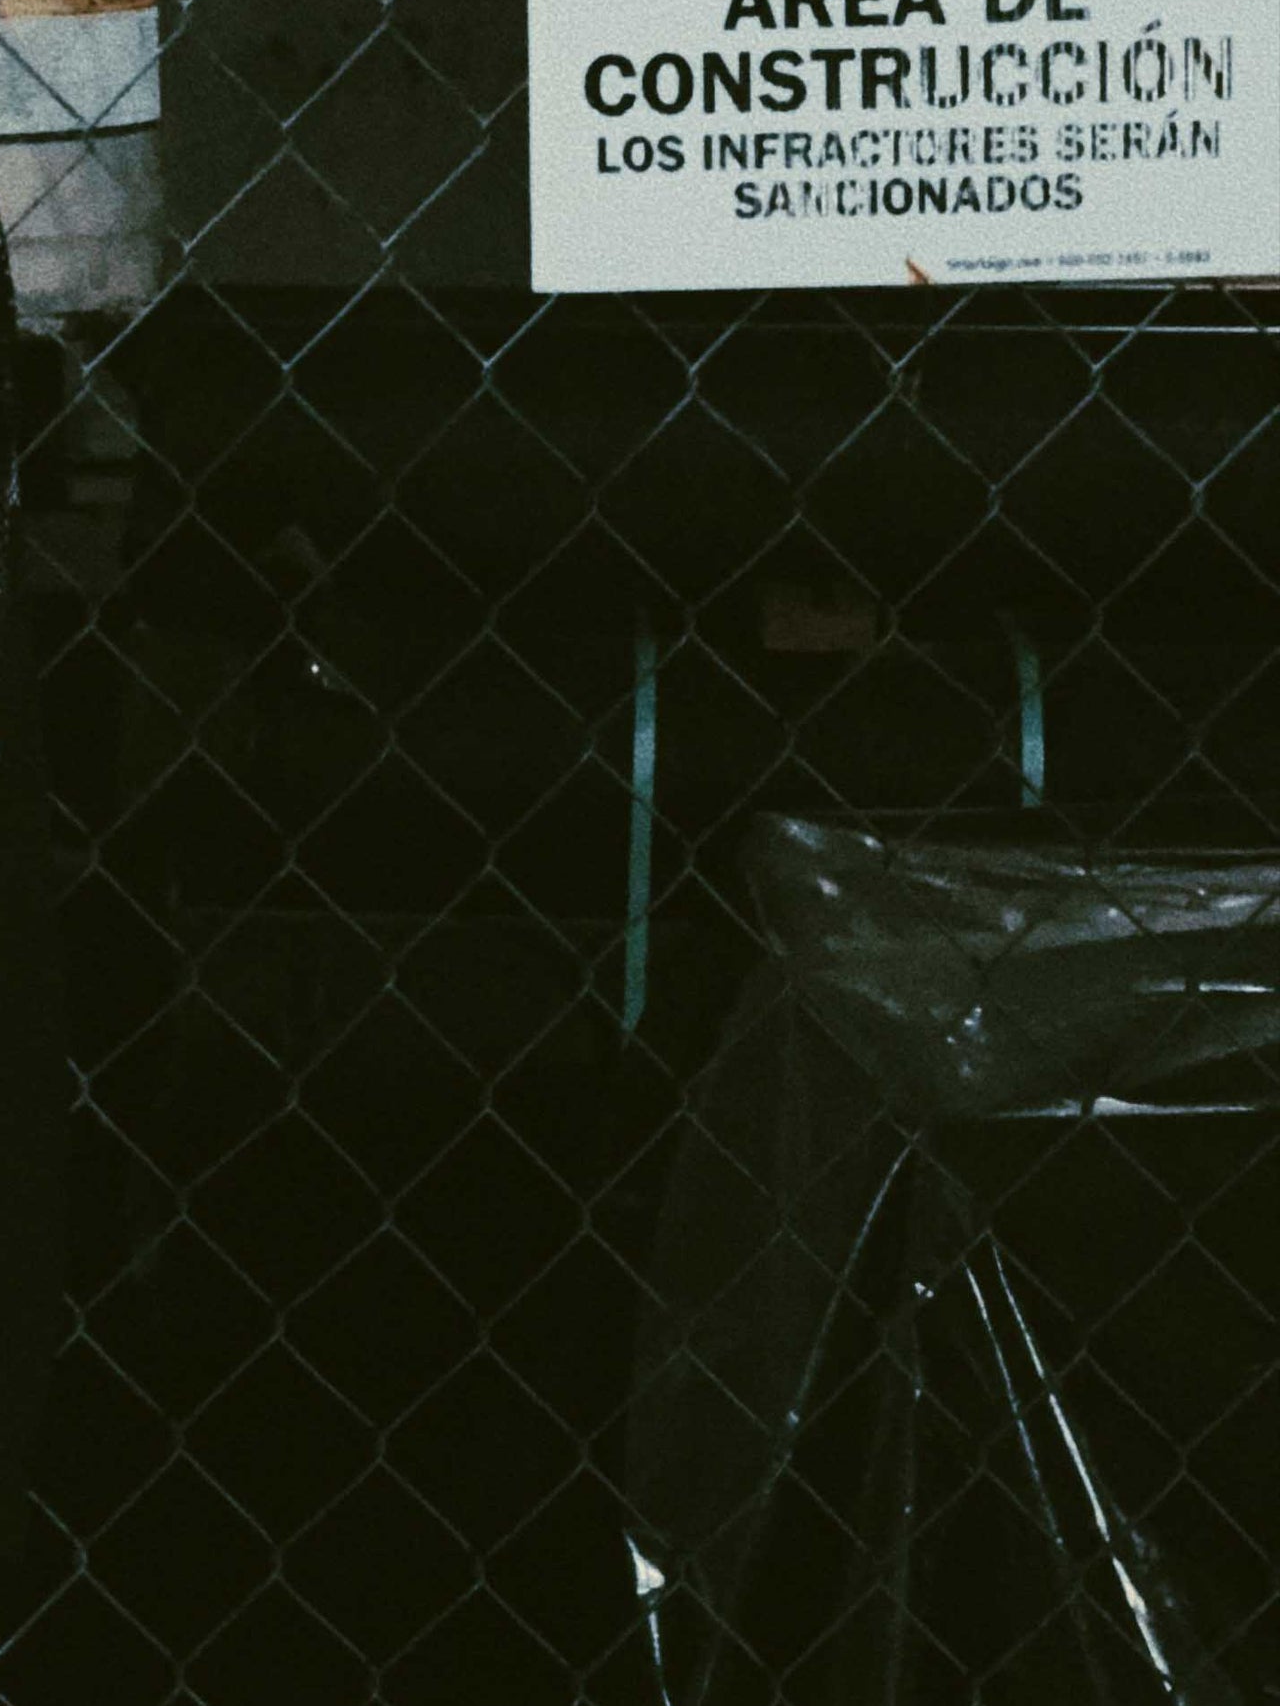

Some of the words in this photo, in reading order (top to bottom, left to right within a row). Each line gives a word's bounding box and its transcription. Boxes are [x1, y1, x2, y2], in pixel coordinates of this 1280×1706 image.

[584, 21, 1233, 117] CONSTRUCCIÓN
[598, 135, 685, 173] LOS
[704, 126, 1038, 170] INFRACTORES
[1056, 109, 1221, 163] SERÁN
[735, 173, 1083, 218] SANCIONADOS
